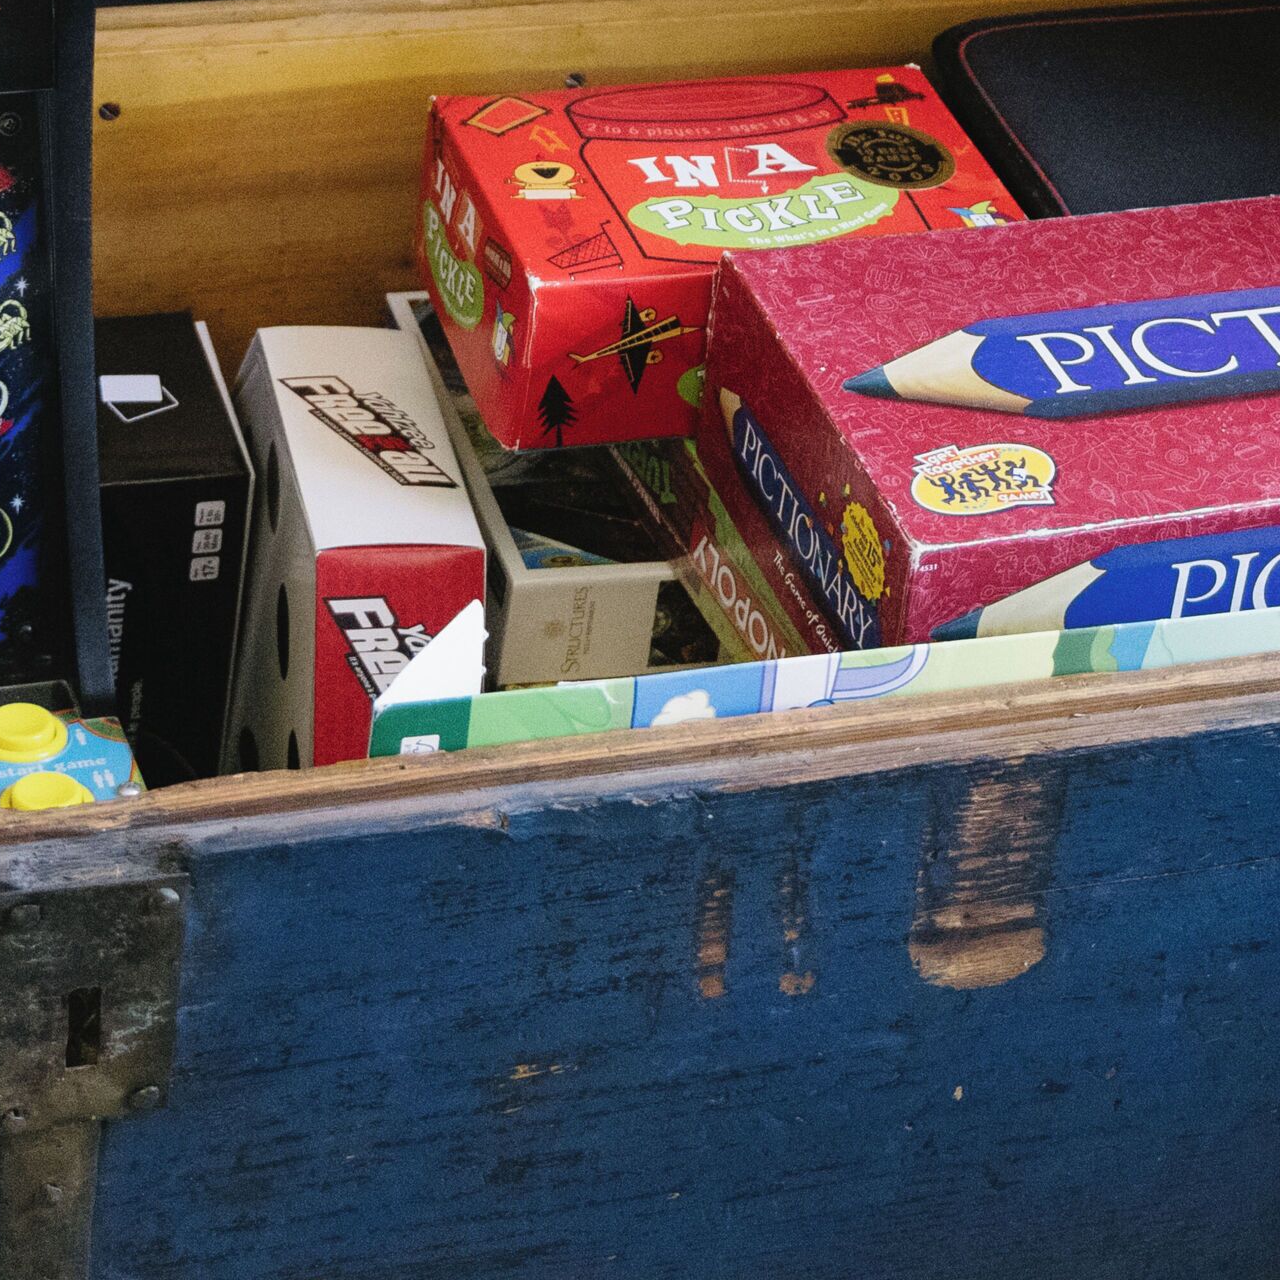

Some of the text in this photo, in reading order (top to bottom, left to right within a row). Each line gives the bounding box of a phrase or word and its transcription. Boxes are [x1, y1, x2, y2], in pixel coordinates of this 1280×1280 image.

[587, 122, 598, 132] 2
[604, 123, 621, 134] to
[629, 126, 638, 135] 6
[646, 124, 711, 138] players
[730, 120, 767, 134] ages
[773, 117, 791, 128] 10
[626, 143, 819, 188] IN A
[646, 180, 867, 233] PICKLE
[427, 207, 477, 308] PICKLE
[740, 419, 873, 650] PICTIONARY
[773, 549, 786, 577] The
[784, 572, 806, 611] Game
[806, 610, 820, 625] of
[53, 757, 108, 773] game
